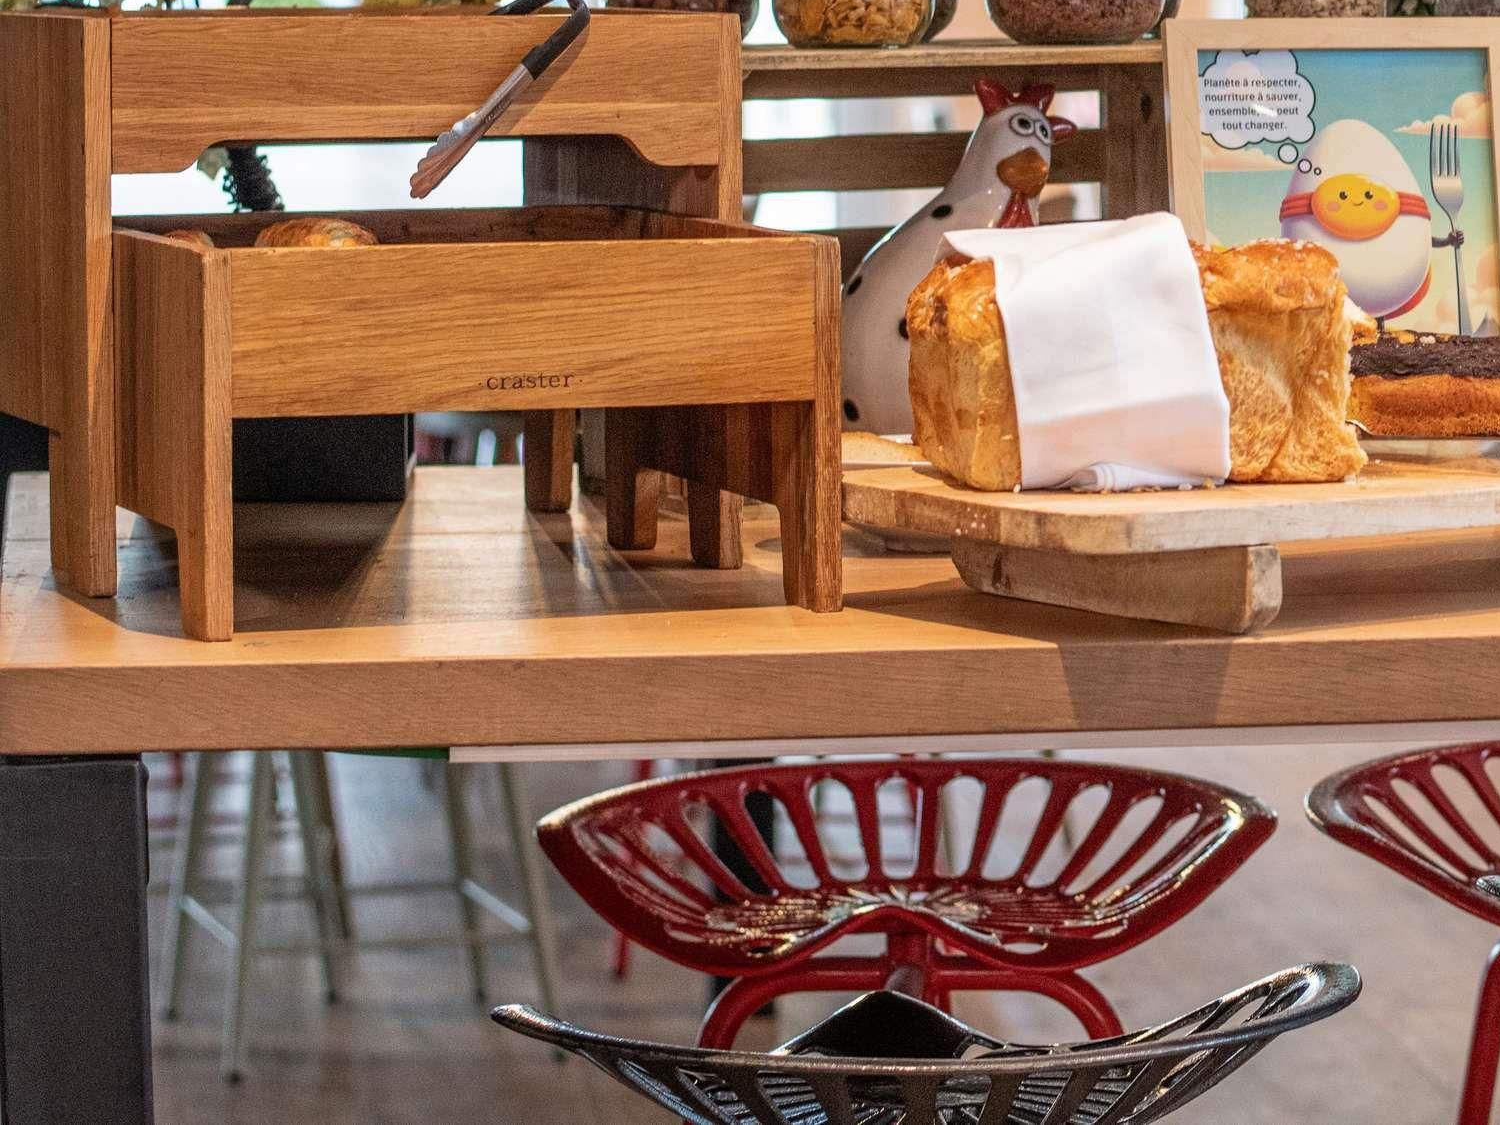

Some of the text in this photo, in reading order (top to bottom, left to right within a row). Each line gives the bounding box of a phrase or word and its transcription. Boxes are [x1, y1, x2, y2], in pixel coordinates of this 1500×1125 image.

[1203, 78, 1301, 89] Planète à respecter,
[1204, 92, 1302, 103] nourriture à sauver,
[1208, 106, 1261, 117] ensemble,
[1277, 107, 1299, 117] peut
[1222, 121, 1287, 132] tout changer.
[487, 372, 575, 391] craster
